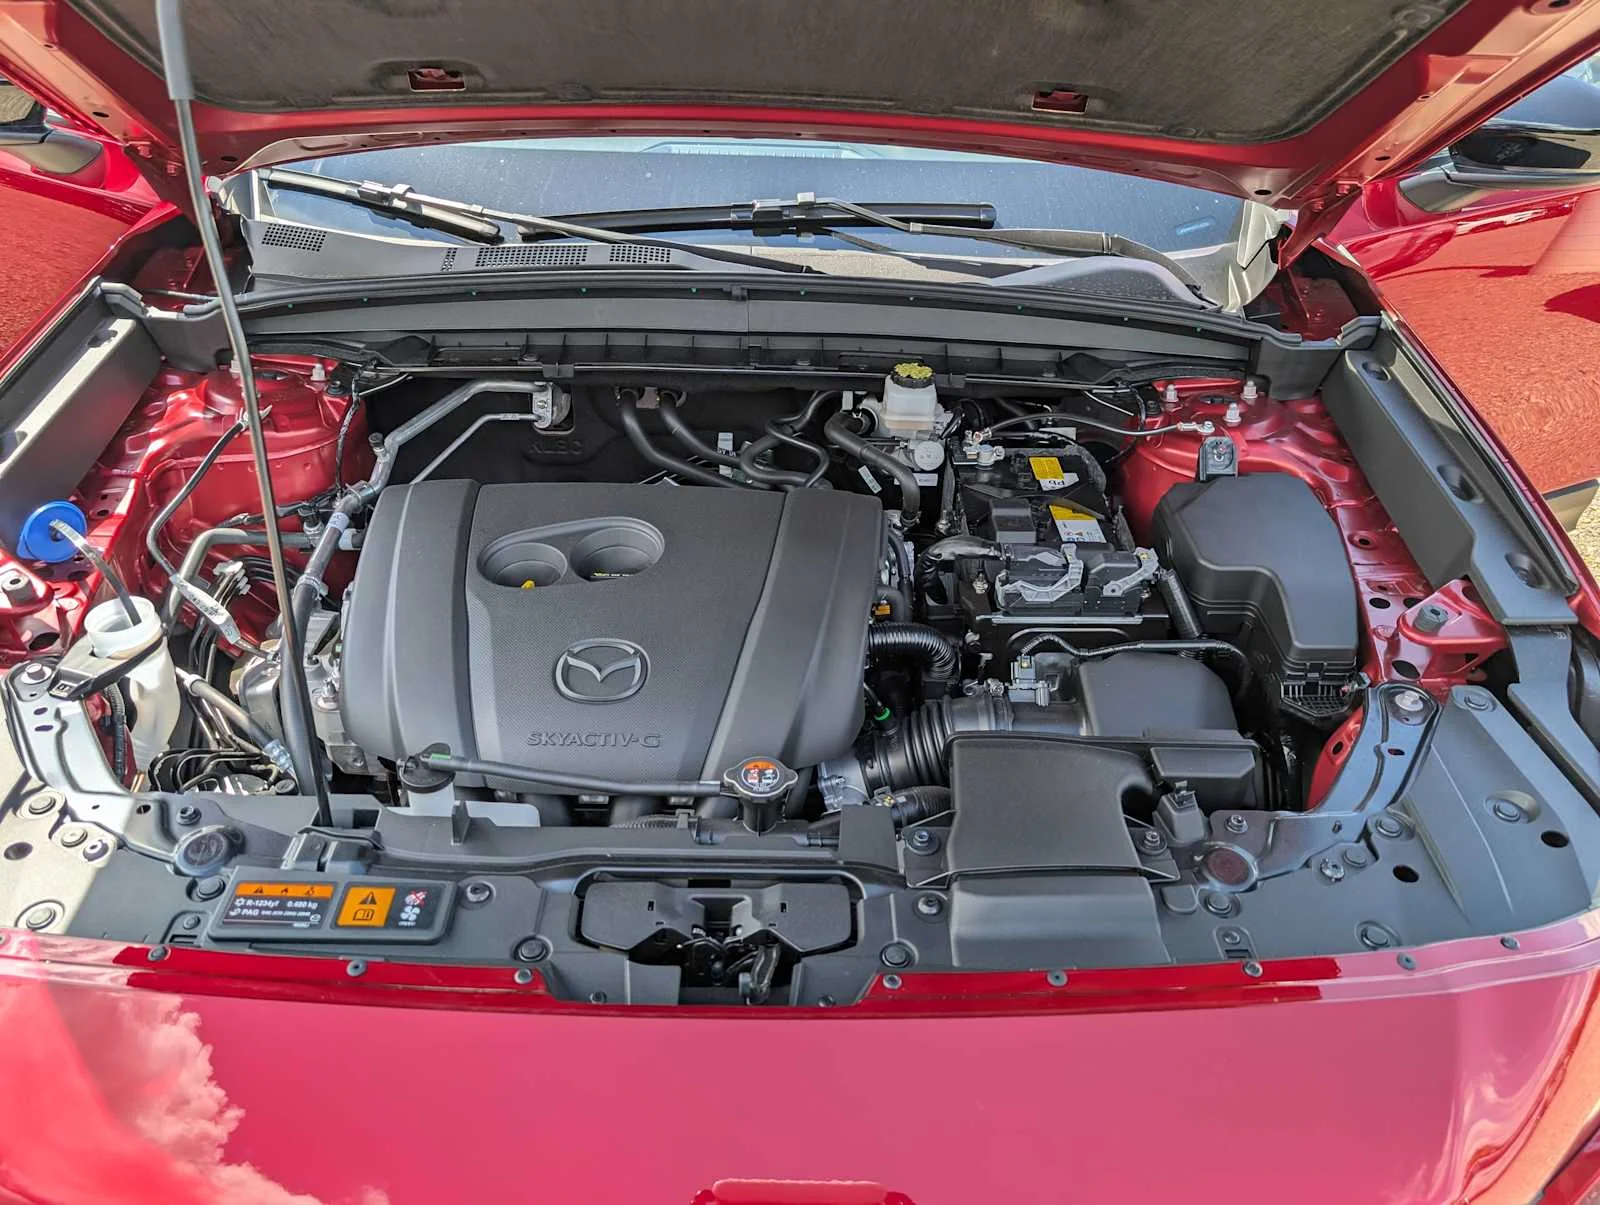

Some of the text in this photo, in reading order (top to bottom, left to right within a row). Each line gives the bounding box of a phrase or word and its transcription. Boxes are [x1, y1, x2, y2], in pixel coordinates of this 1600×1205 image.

[526, 731, 662, 749] SKYACTIV-G
[246, 899, 280, 908] R-1234yf
[241, 908, 260, 916] PAG
